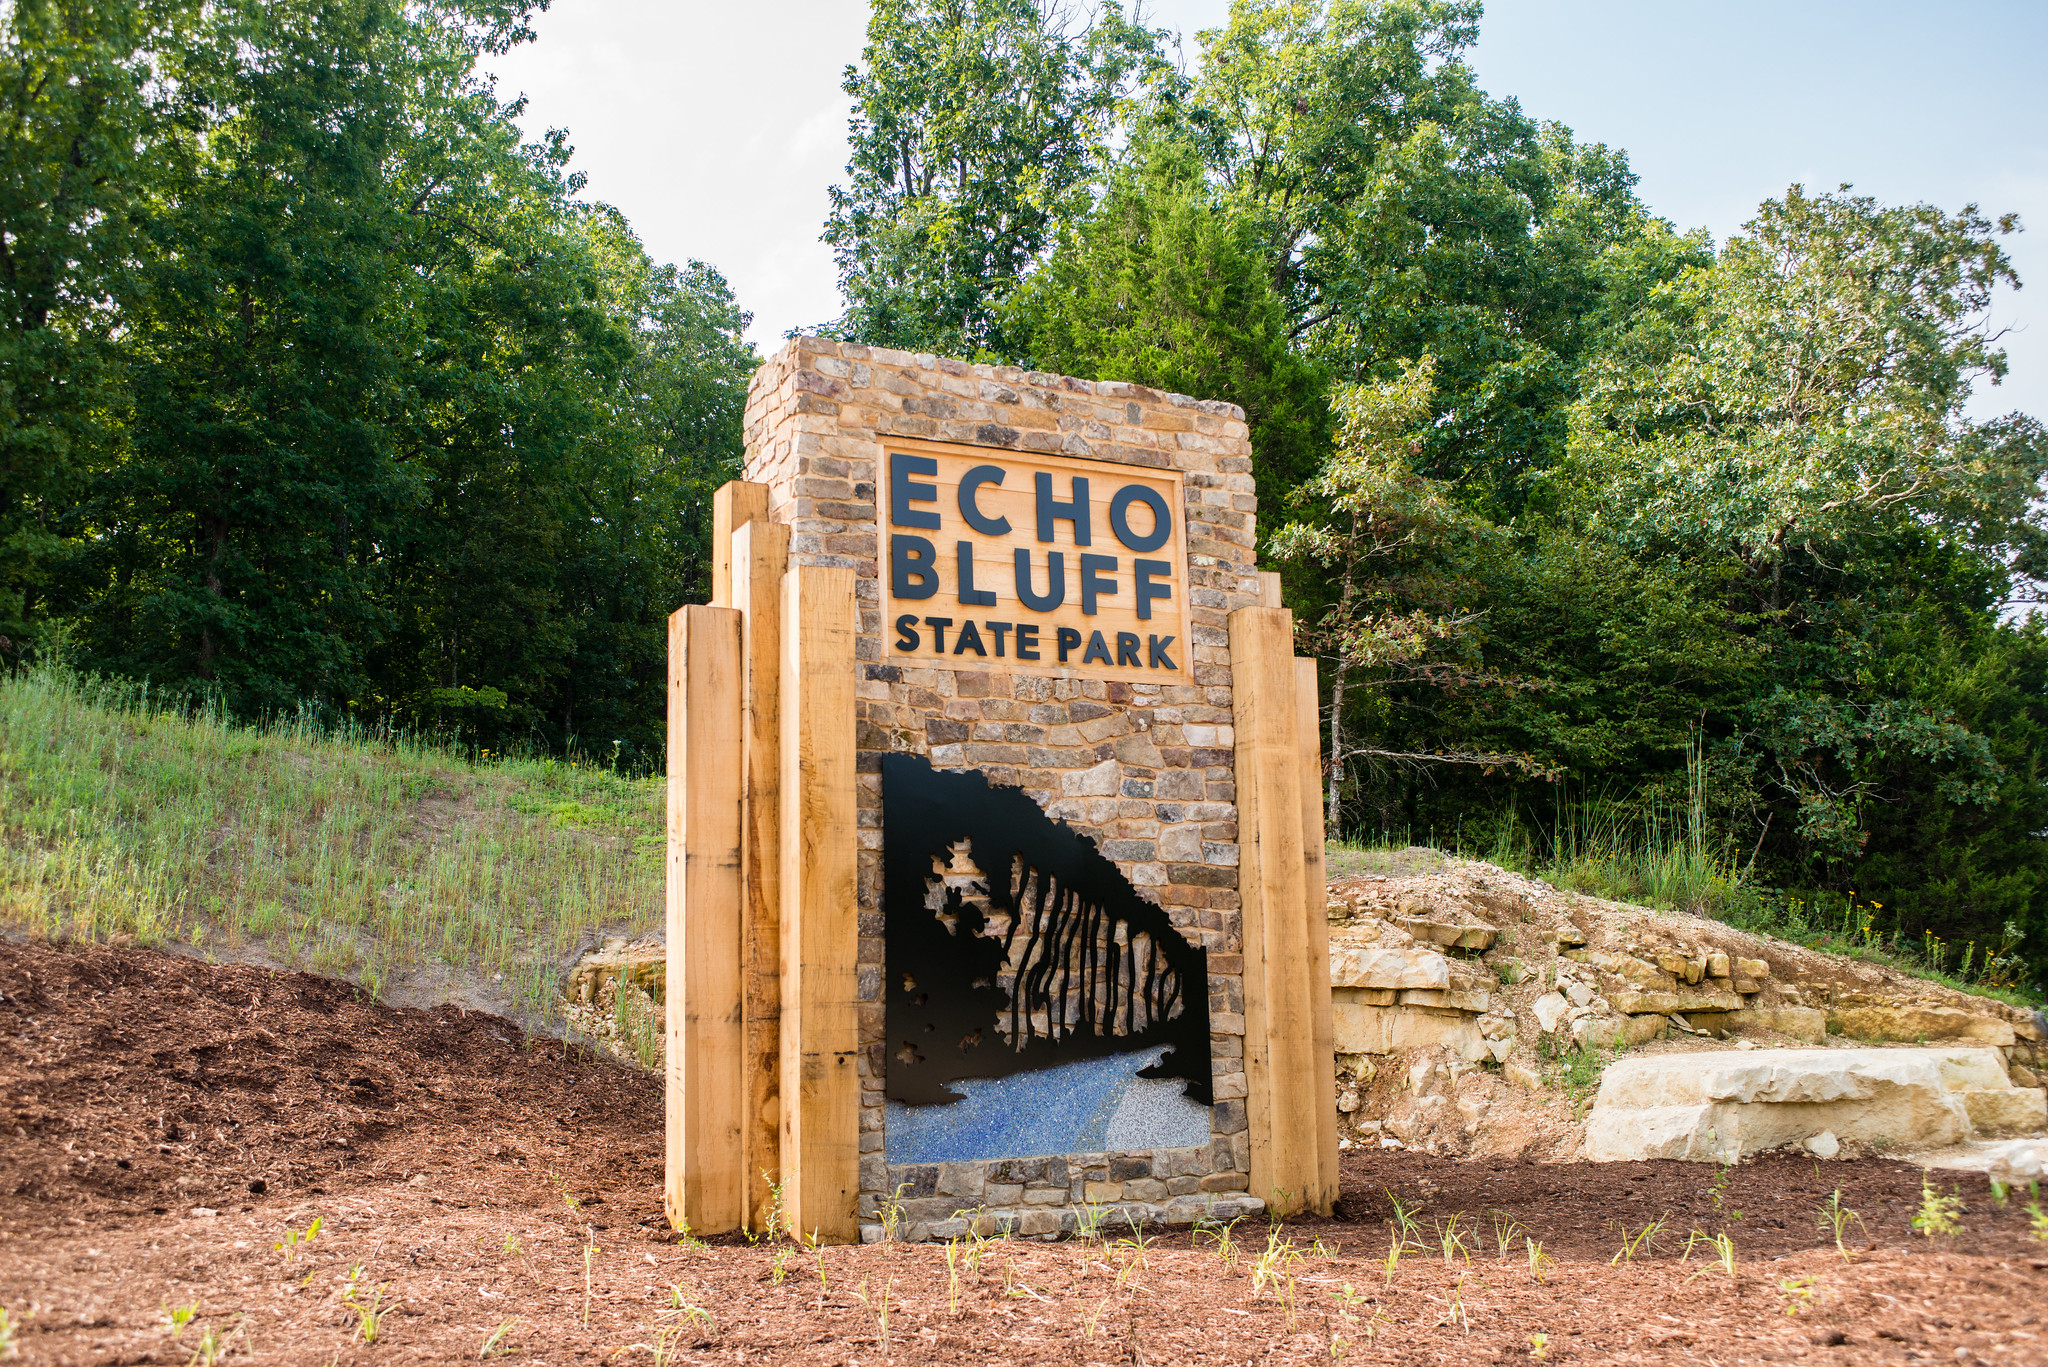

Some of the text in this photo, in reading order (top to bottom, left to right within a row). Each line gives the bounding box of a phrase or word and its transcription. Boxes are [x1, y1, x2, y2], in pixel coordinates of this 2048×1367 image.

[891, 453, 1172, 552] ECHO
[891, 533, 1172, 620] BLUFF
[895, 614, 1178, 670] STATE PARK
